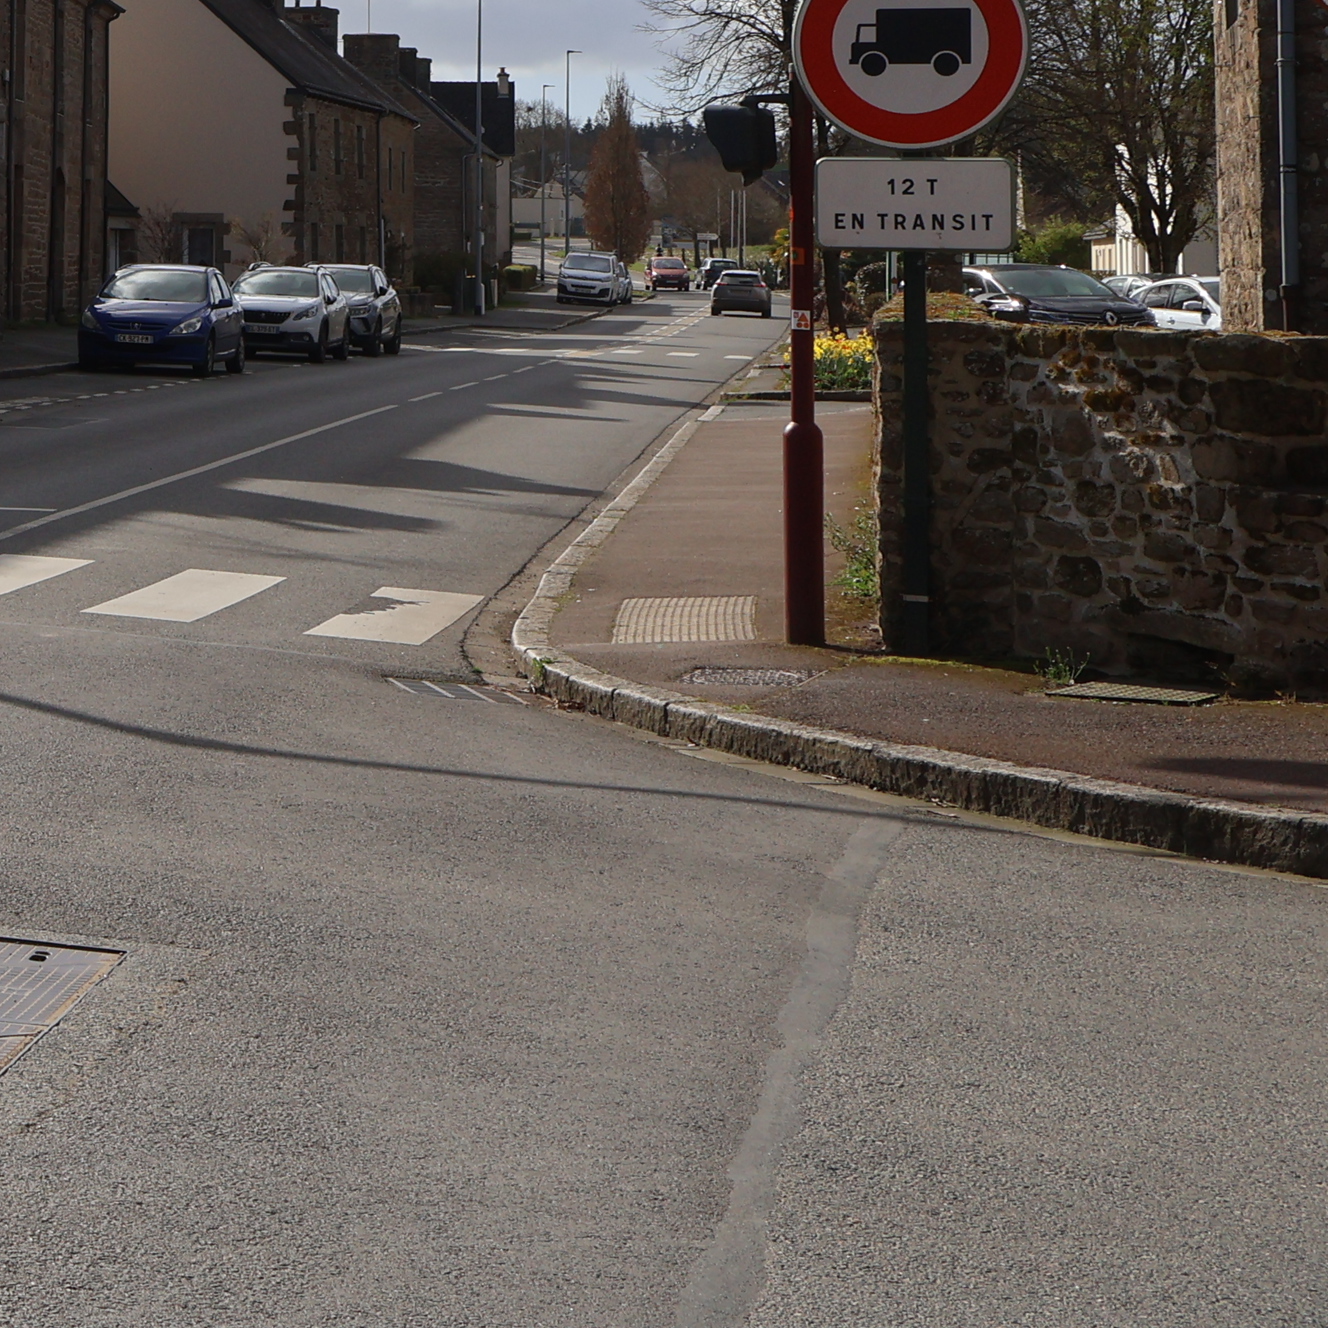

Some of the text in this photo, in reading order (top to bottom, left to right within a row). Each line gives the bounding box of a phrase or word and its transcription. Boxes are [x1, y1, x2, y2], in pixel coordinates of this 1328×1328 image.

[886, 178, 938, 196] 12 T
[834, 213, 994, 231] EN TRANSIT
